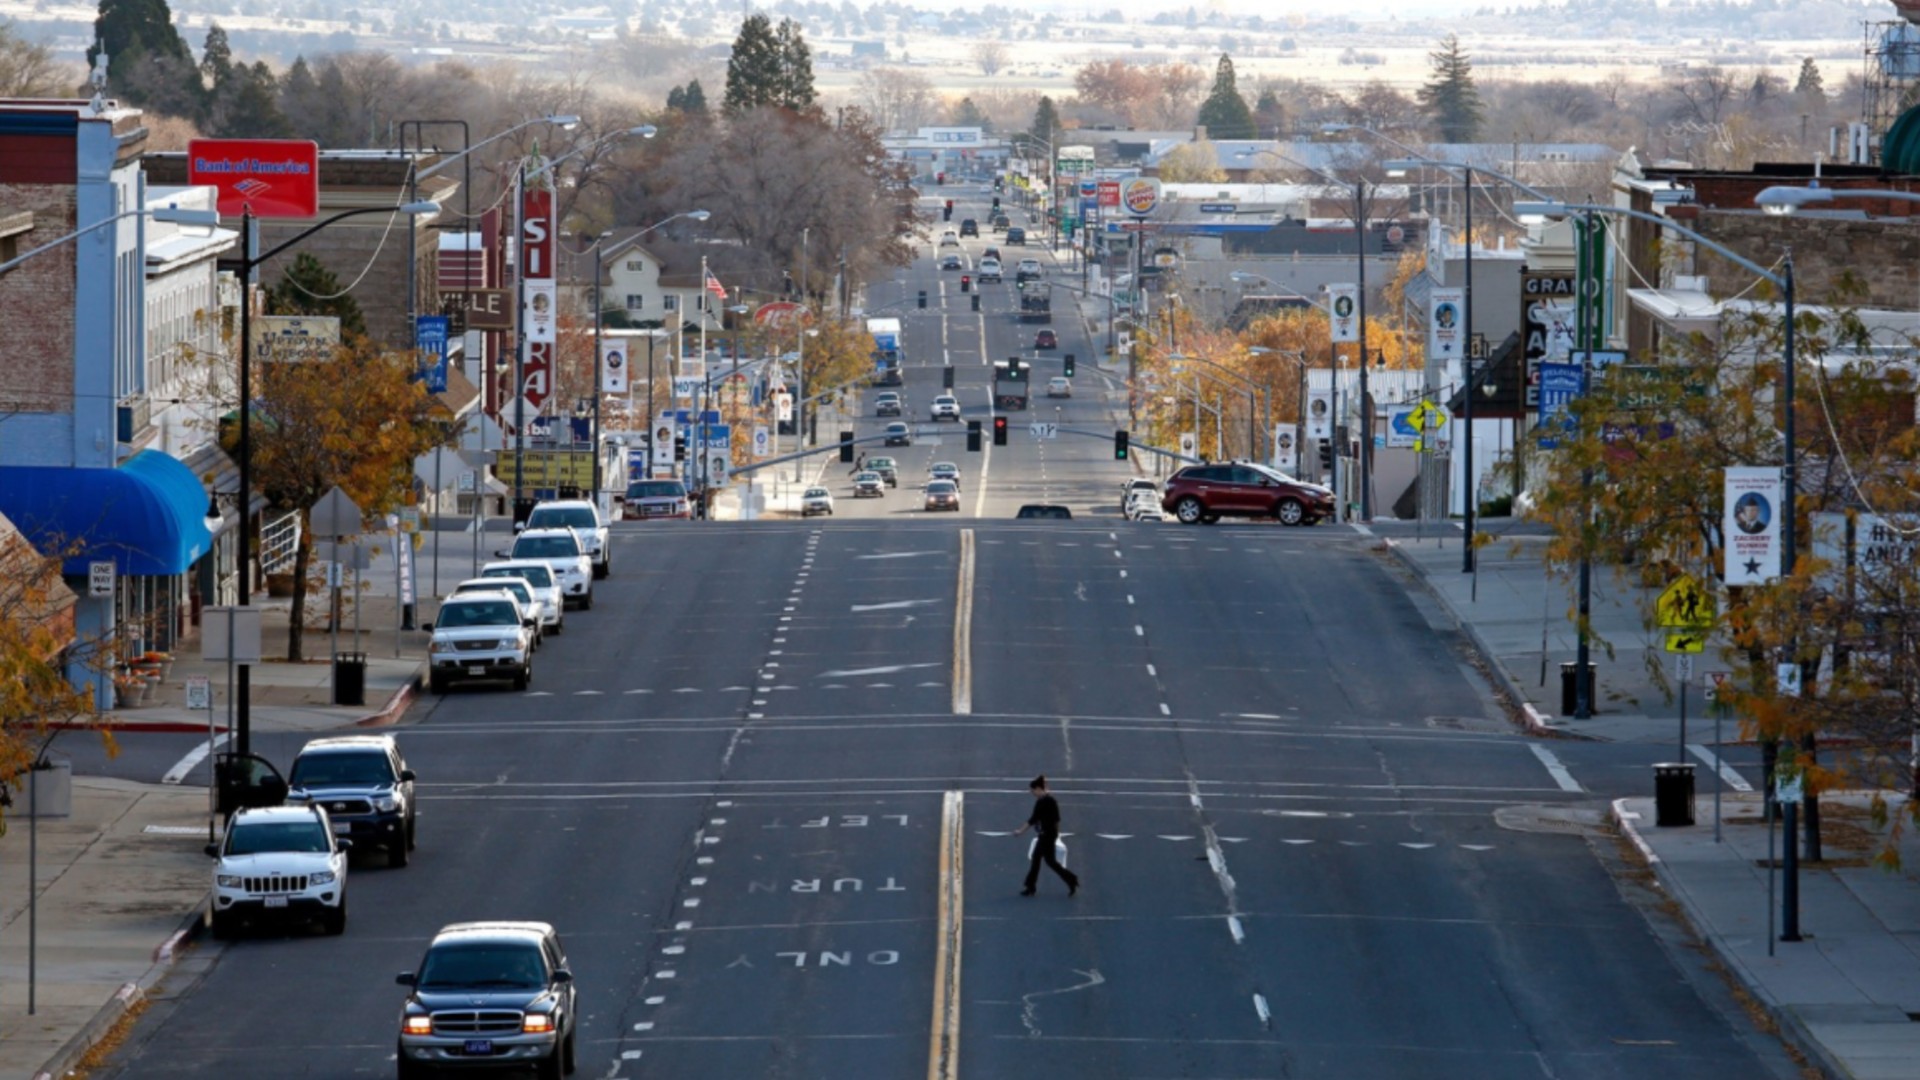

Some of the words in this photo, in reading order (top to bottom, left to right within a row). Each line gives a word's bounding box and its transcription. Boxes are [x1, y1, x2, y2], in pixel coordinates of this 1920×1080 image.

[196, 158, 231, 173] Bank
[235, 159, 248, 173] of
[251, 159, 309, 174] America
[1526, 278, 1575, 293] GRA
[523, 218, 547, 395] SIRA
[93, 565, 112, 574] ONE
[93, 575, 112, 584] WAY
[761, 814, 908, 829] LEFT
[748, 876, 907, 894] TURN
[724, 950, 900, 969] ONLY
